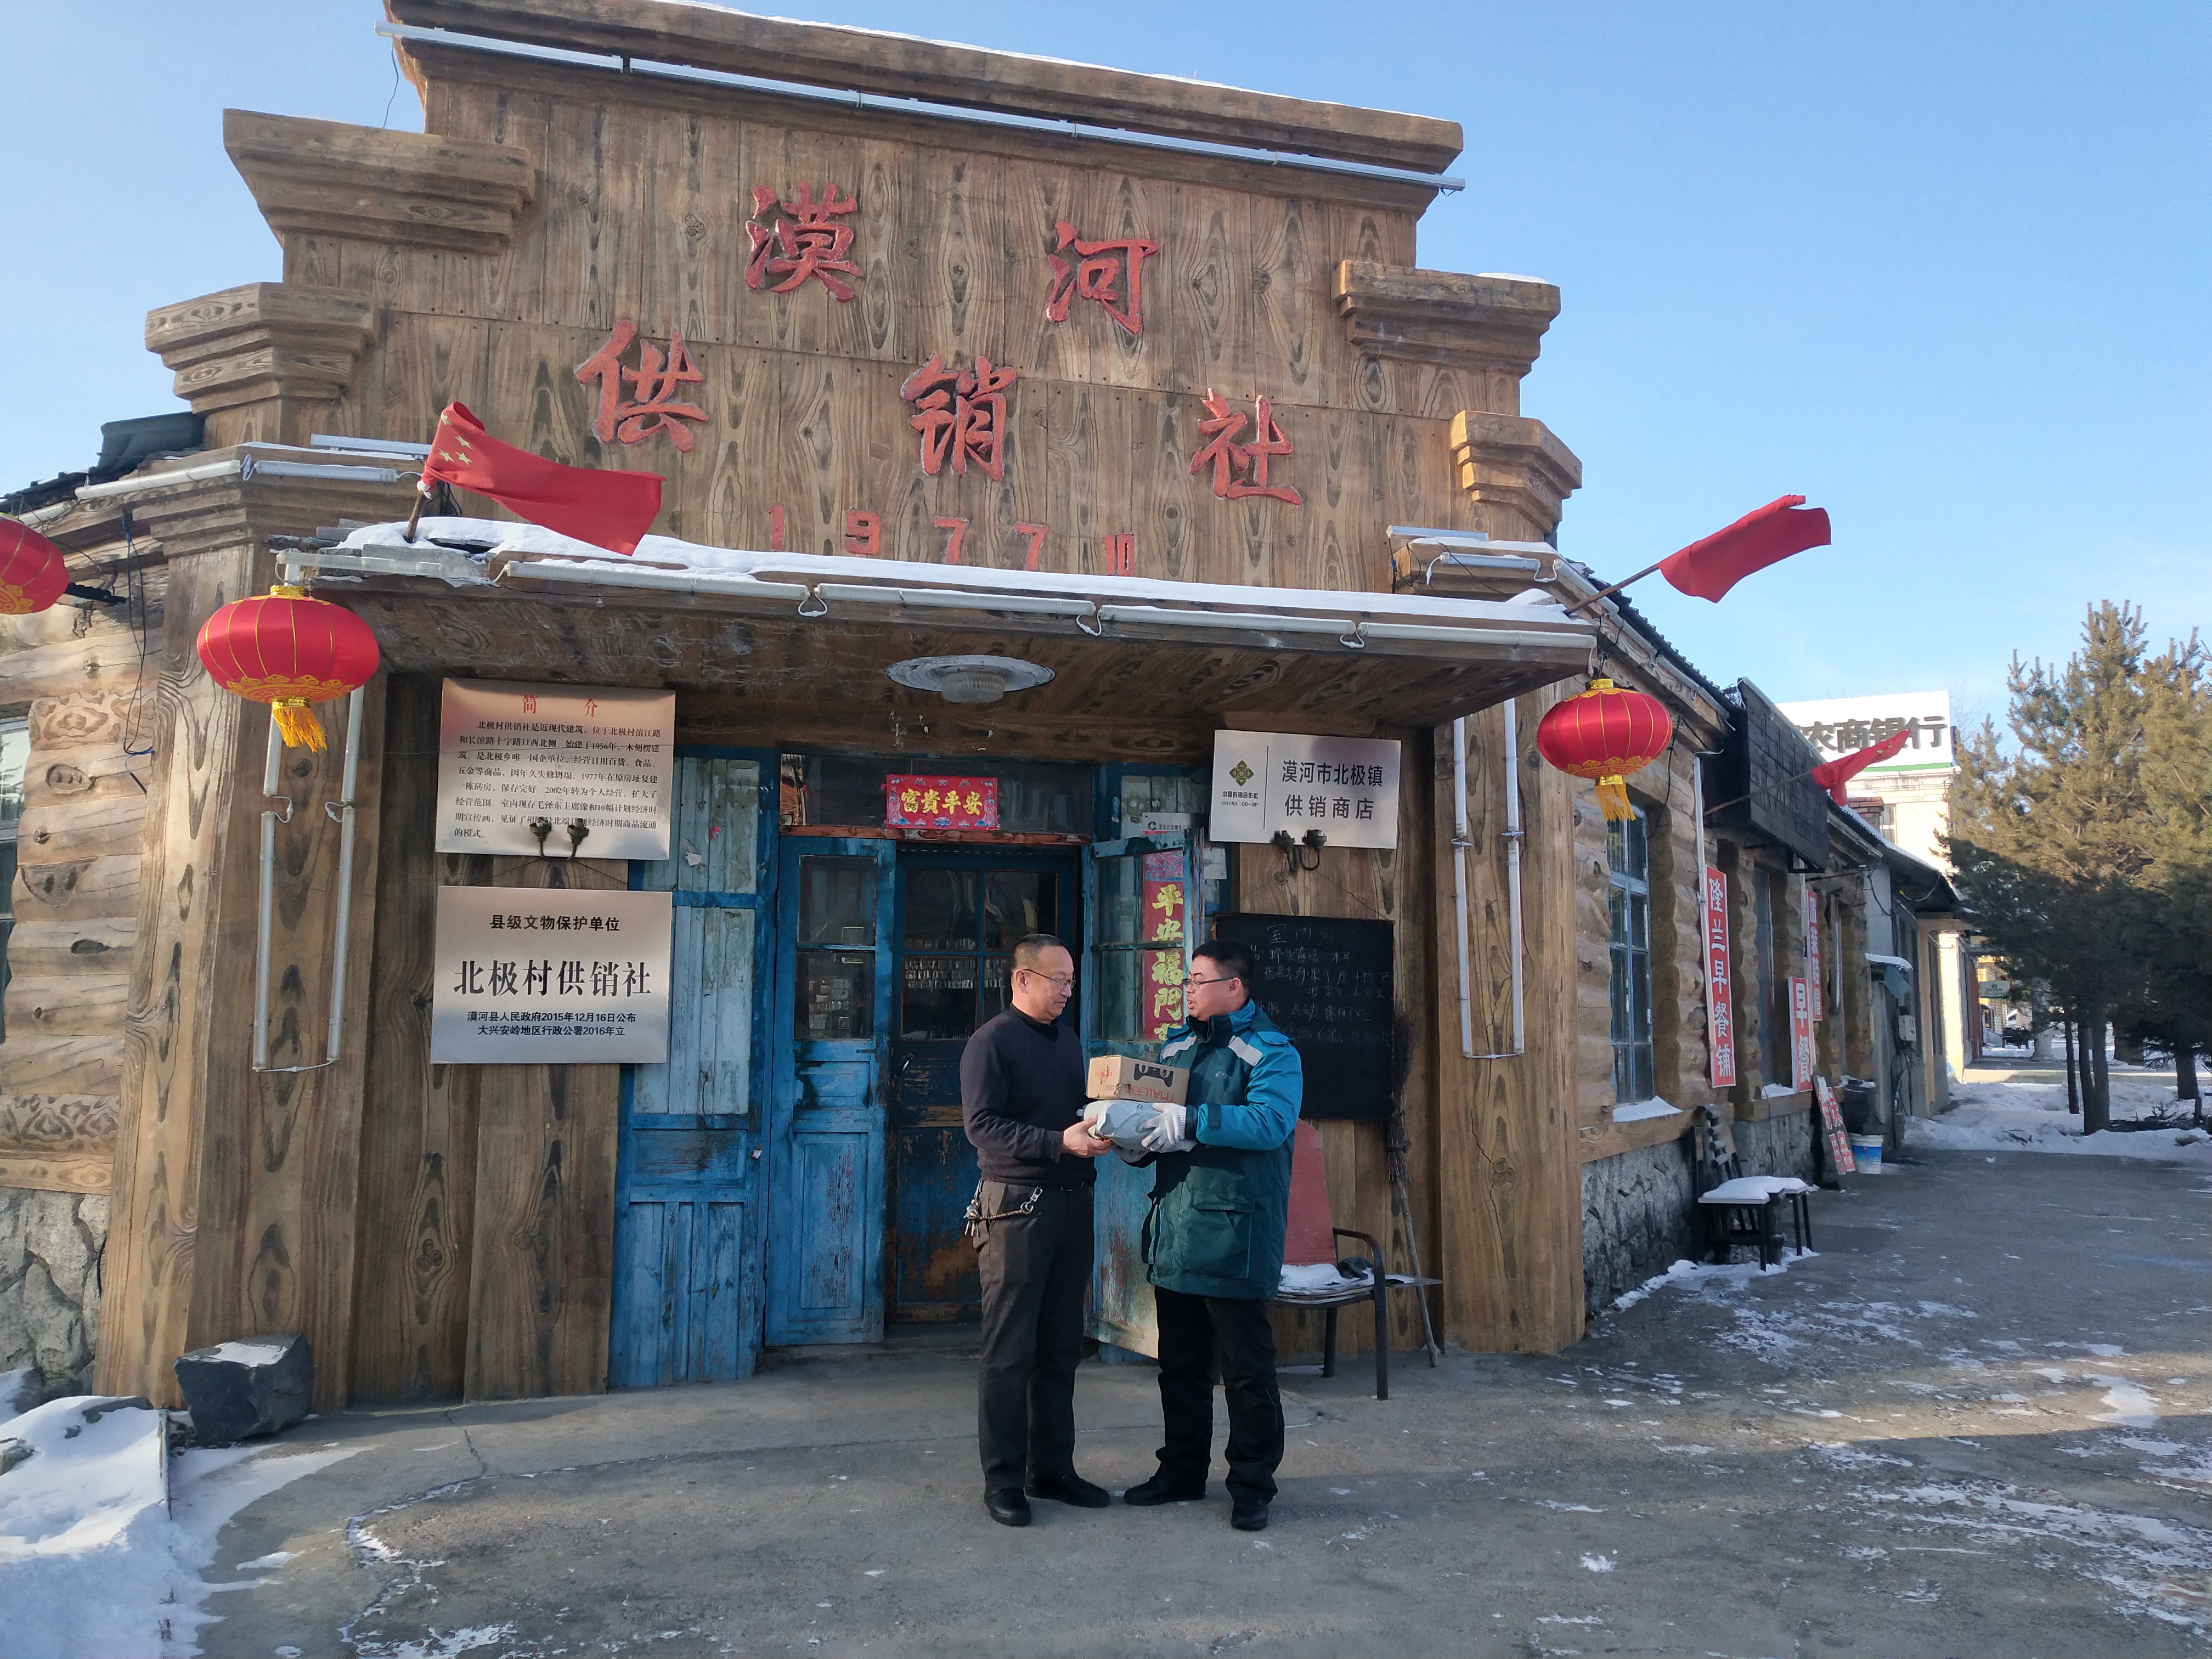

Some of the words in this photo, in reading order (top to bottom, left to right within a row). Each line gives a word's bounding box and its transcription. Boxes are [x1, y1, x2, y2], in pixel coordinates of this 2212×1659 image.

[745, 182, 1159, 334] 漠河
[574, 320, 1302, 505] 供销社
[522, 694, 599, 718] 简介
[1282, 760, 1383, 787] 漠河市北极镇
[1285, 794, 1374, 820] 供销商店
[489, 915, 620, 932] 县级文物保护单位
[453, 960, 651, 997] 北极村供销社
[467, 1011, 636, 1023] 漠河县人民政府2015年12月16日公布
[478, 1025, 625, 1037] 大兴安岭地区行政公署2016年立
[1796, 983, 1810, 1084] 早餐
